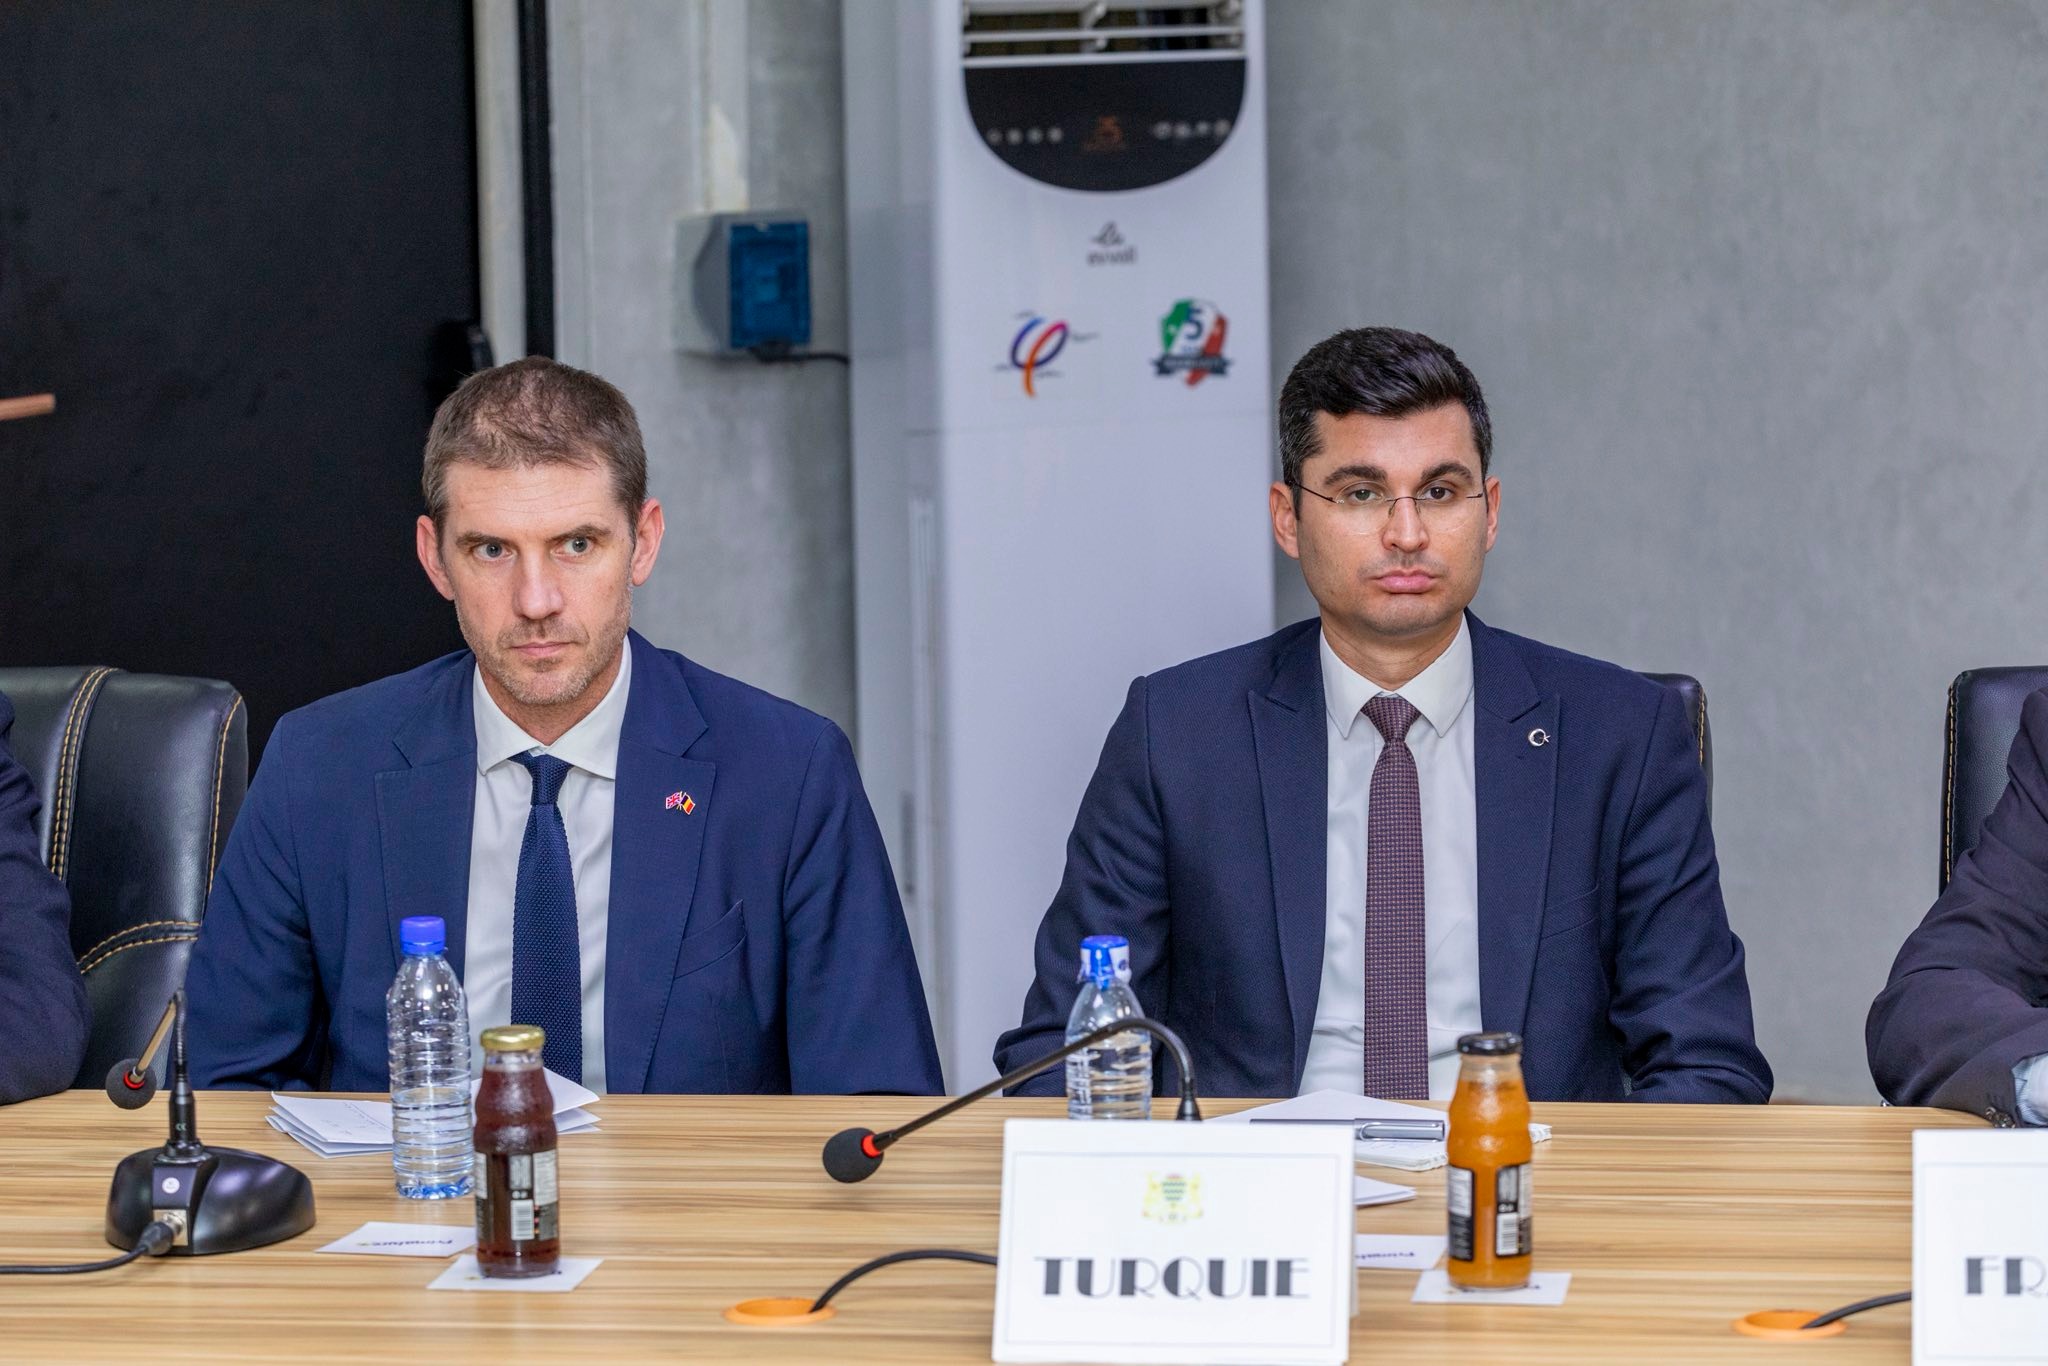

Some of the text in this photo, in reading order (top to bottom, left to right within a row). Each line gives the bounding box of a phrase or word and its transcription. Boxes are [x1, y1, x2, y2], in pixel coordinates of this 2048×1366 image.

[1184, 307, 1203, 340] 5
[1034, 1256, 1310, 1302] TURQUIE
[1965, 1255, 2048, 1299] FR
